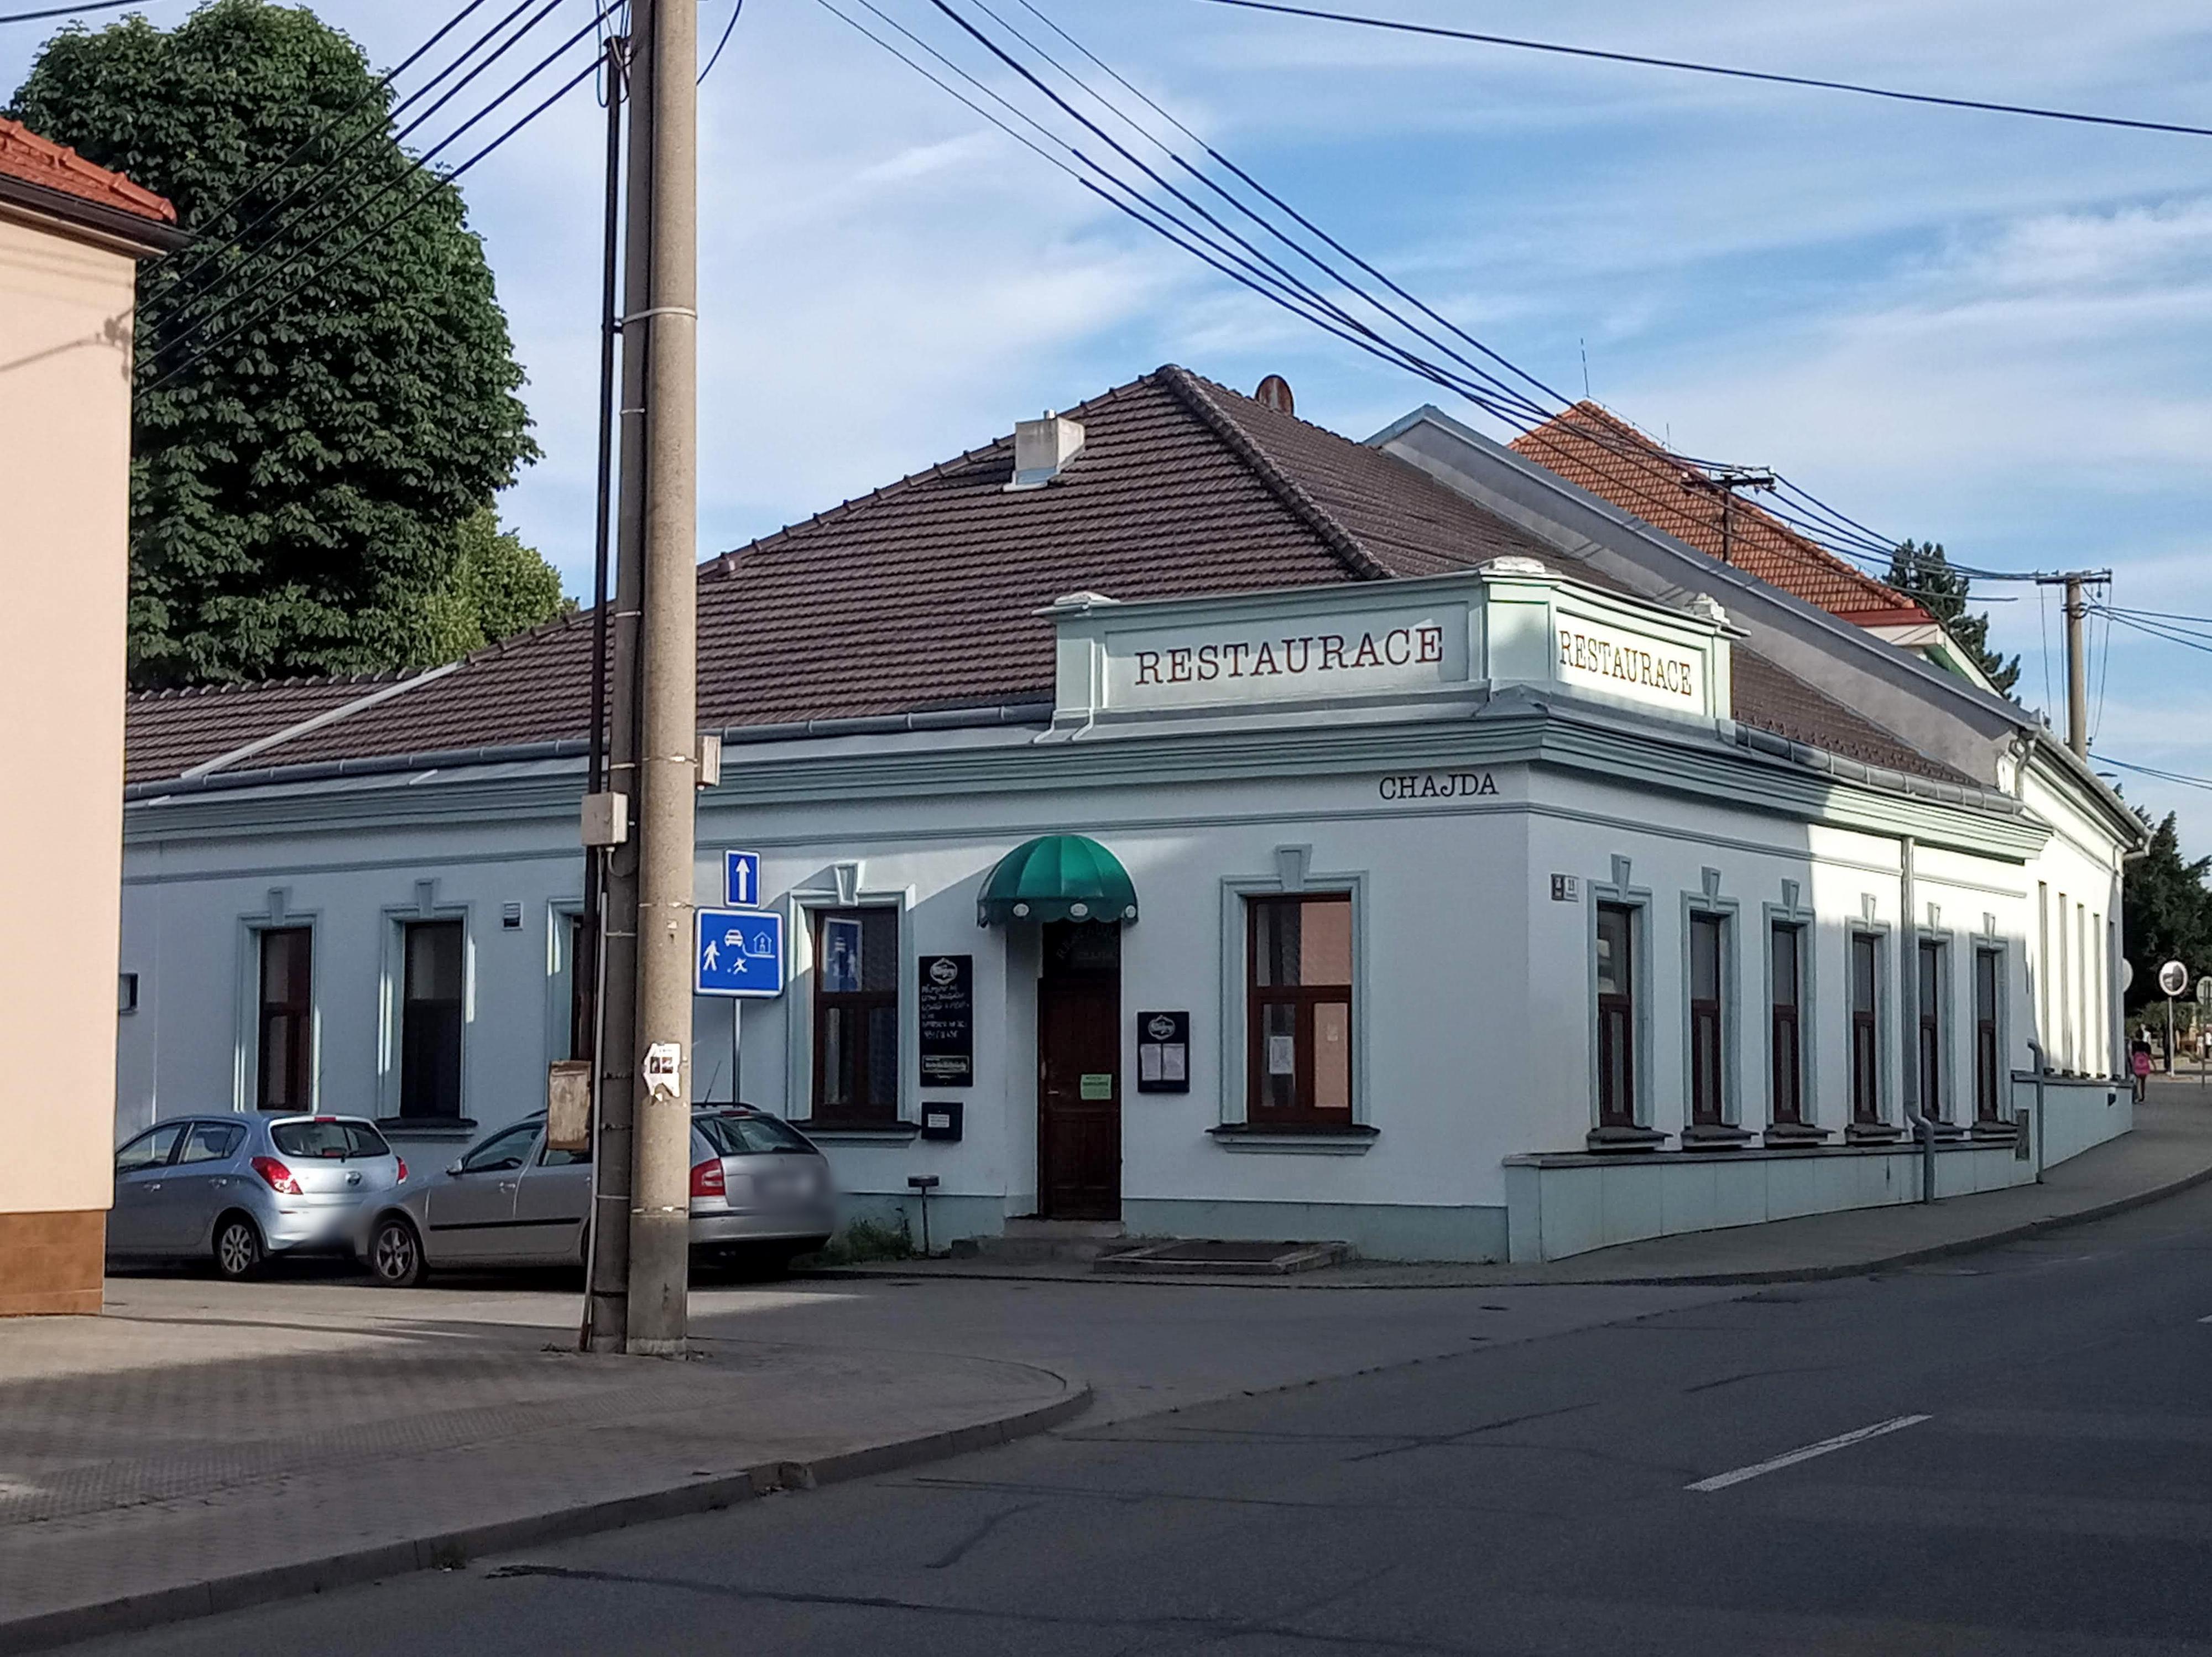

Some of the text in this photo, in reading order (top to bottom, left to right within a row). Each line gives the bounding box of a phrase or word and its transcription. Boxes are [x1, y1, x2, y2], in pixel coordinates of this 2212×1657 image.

[1134, 626, 1443, 686] RESTAURACE
[1559, 630, 1692, 697] RESTAURACE
[1379, 773, 1499, 800] CHAJDA
